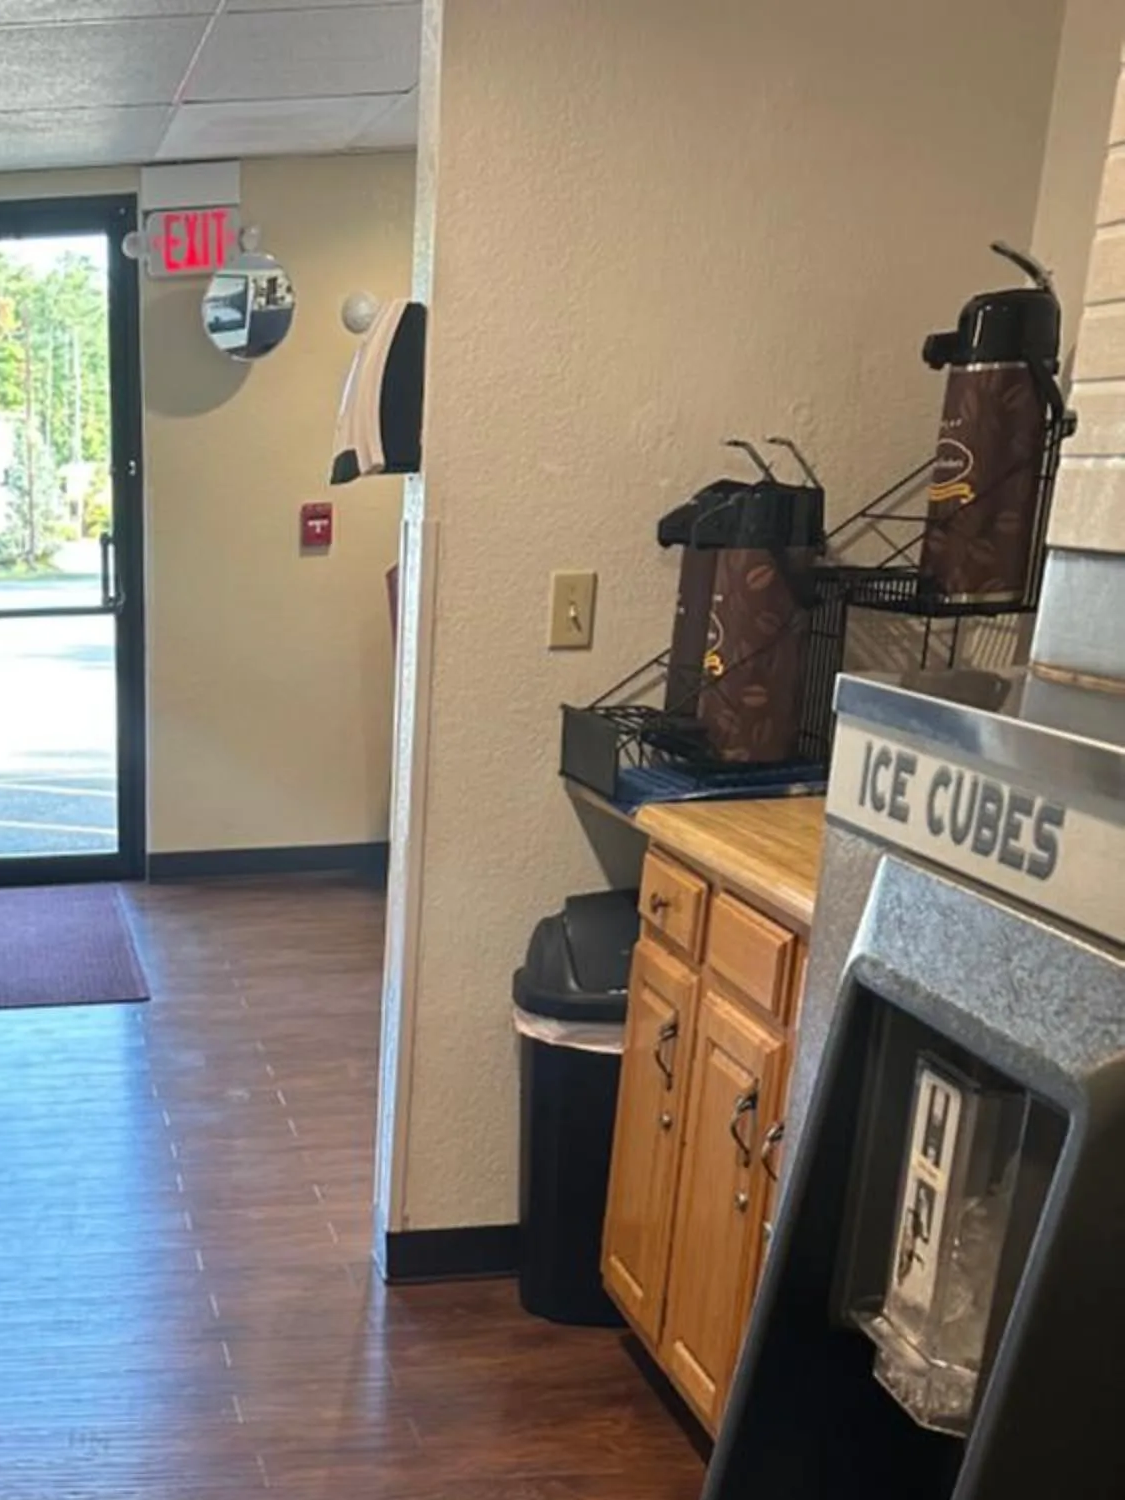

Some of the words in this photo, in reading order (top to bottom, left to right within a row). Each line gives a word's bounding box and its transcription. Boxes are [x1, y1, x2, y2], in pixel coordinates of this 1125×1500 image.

[163, 209, 227, 272] EXIT
[858, 740, 918, 824] ICE
[927, 764, 1066, 882] CUBES
